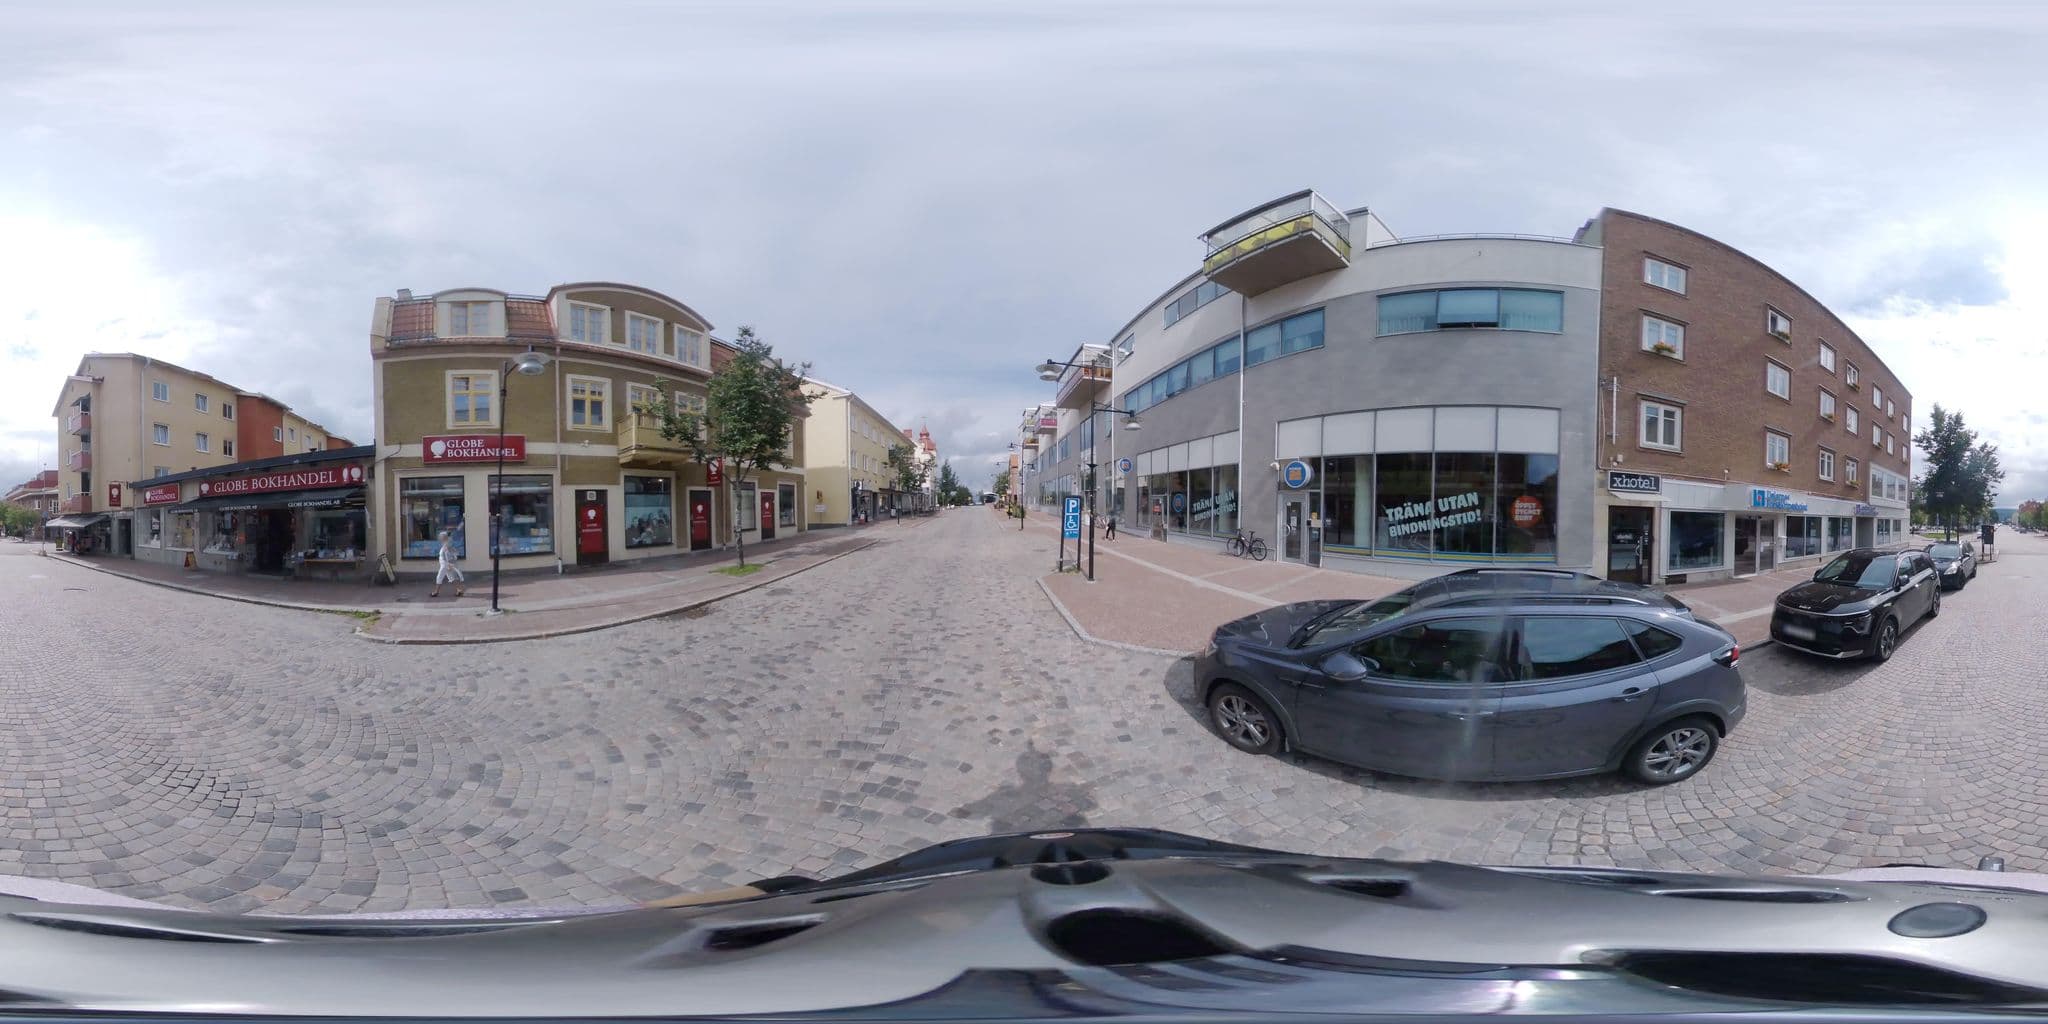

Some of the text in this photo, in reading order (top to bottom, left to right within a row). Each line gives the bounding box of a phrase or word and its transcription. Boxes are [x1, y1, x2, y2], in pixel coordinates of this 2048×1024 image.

[446, 439, 485, 448] GLOBE
[447, 448, 518, 457] BOKHANDEL
[213, 470, 337, 493] GLOBE BOKHANDEL
[1612, 474, 1657, 490] xhotel
[1070, 499, 1078, 513] P
[1385, 492, 1480, 522] TRÄNA UTAN
[1388, 509, 1482, 538] BINDNINGSTID!
